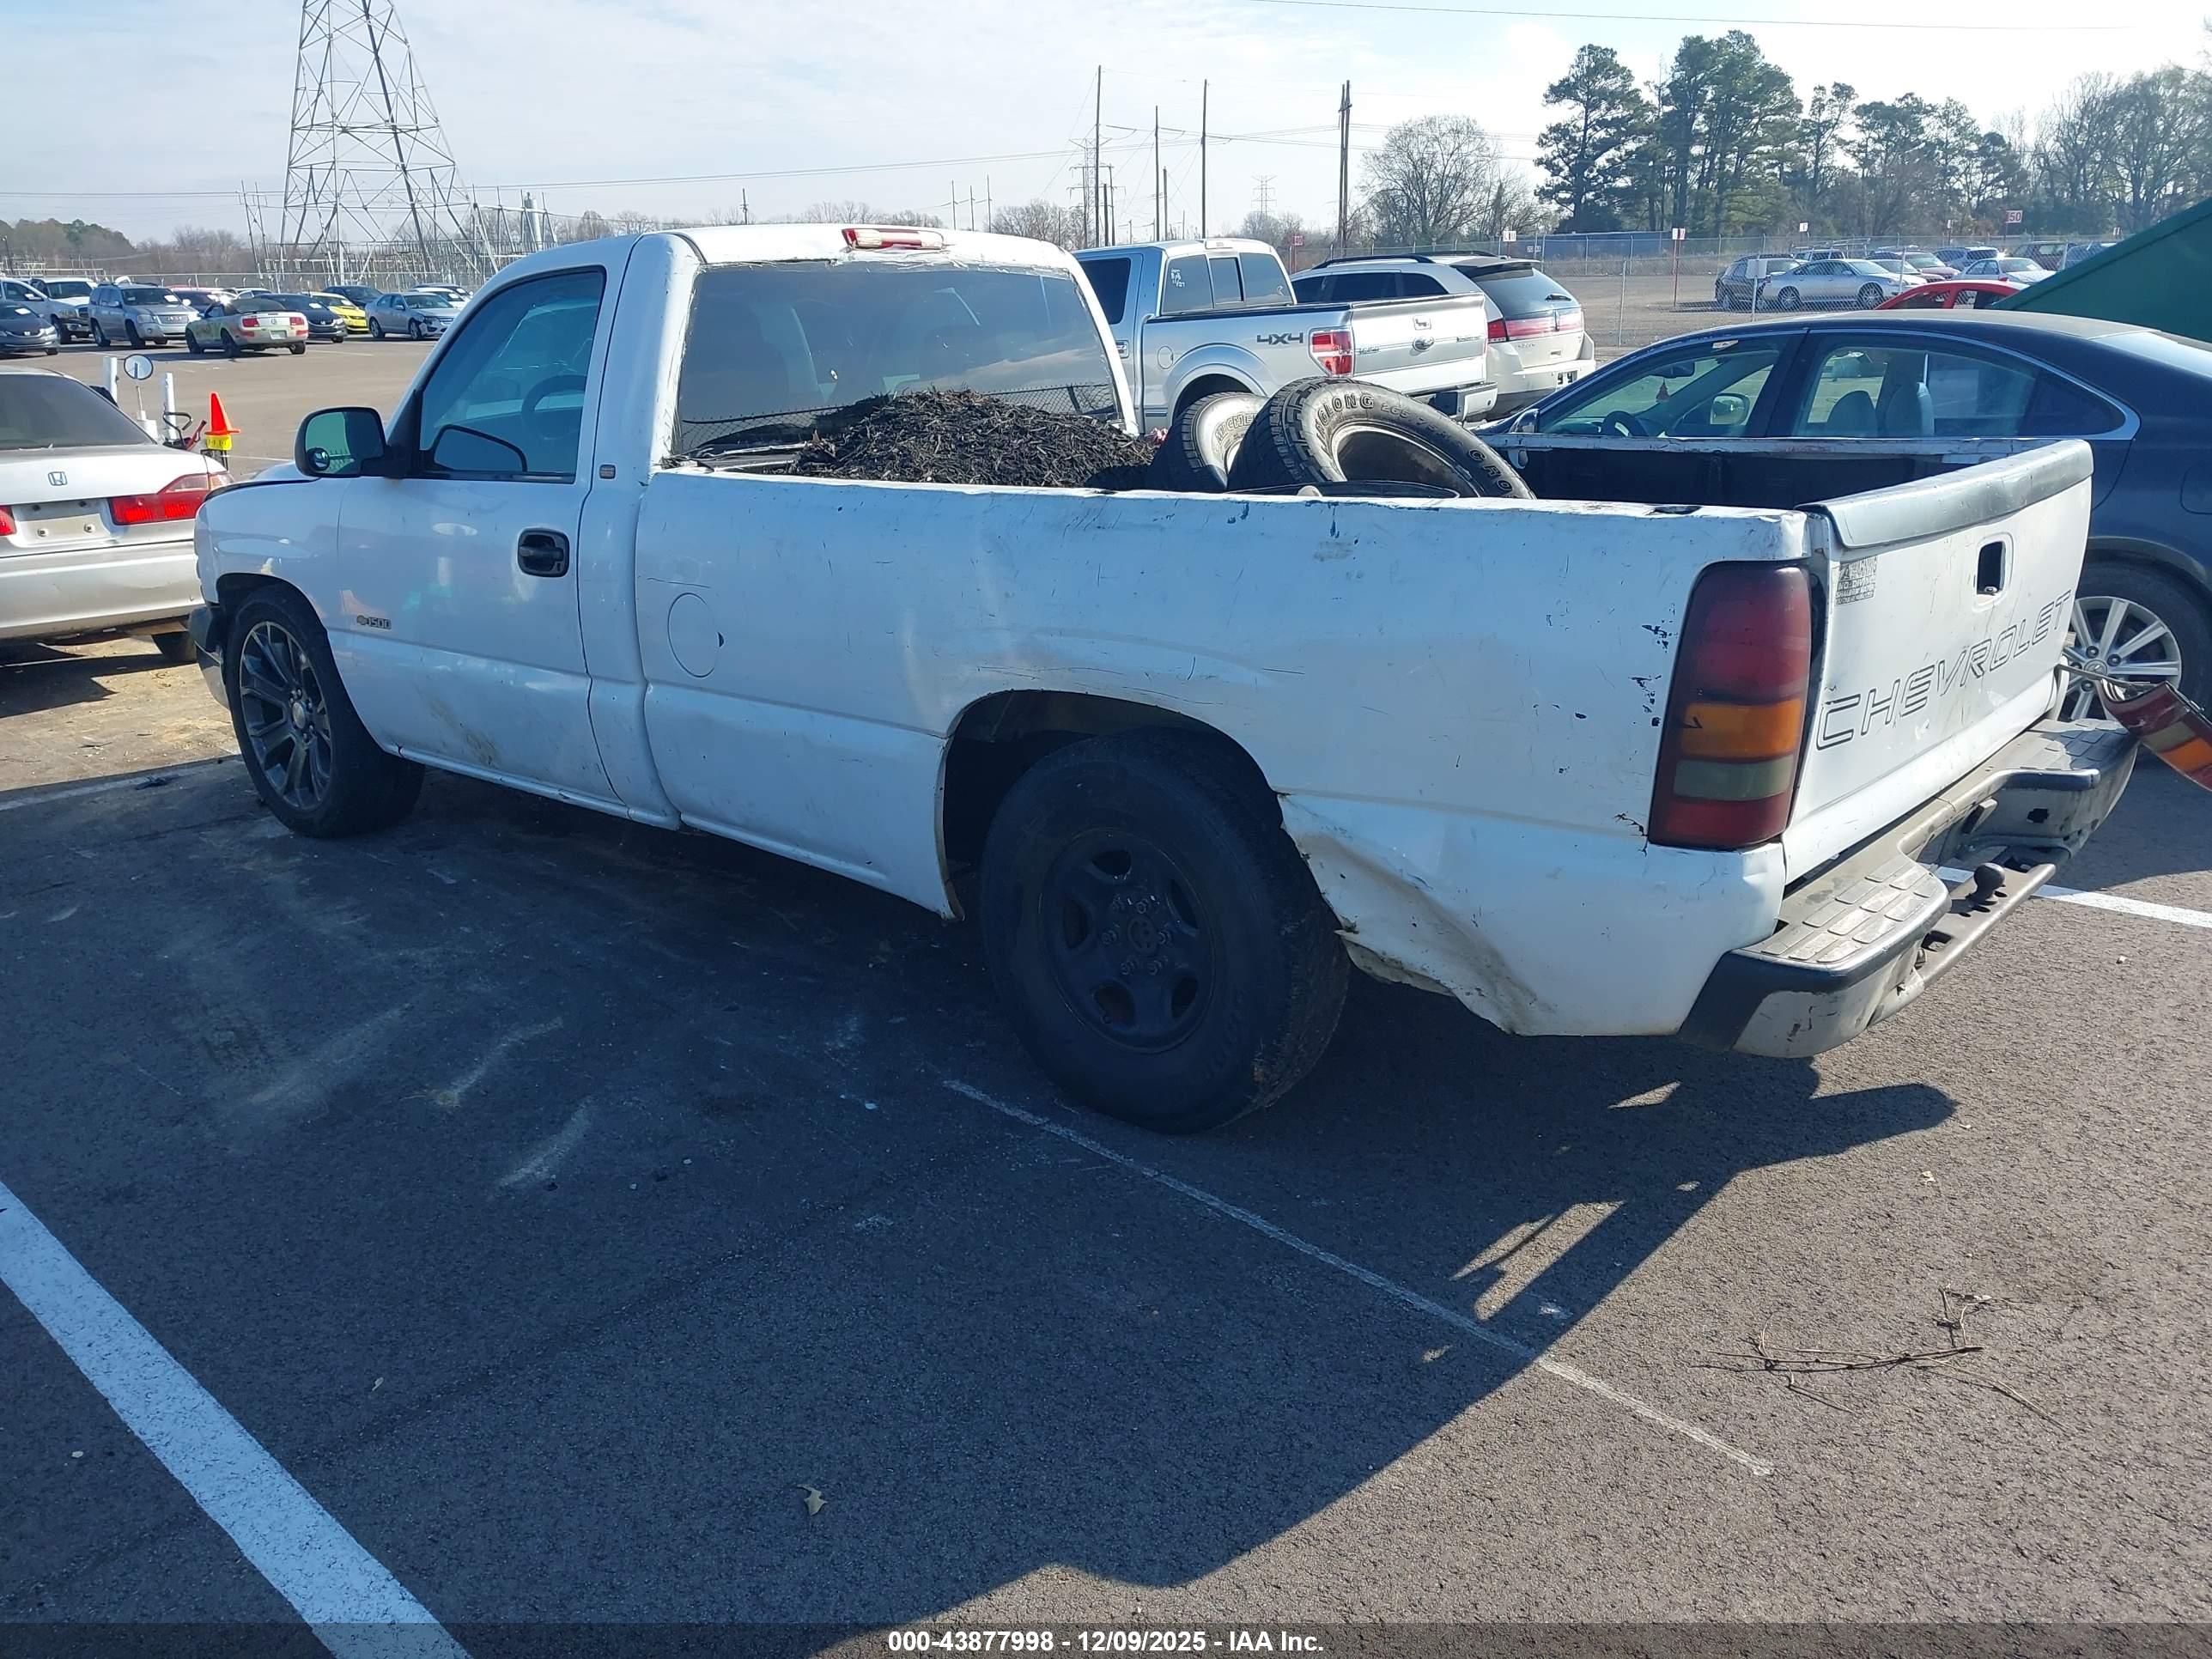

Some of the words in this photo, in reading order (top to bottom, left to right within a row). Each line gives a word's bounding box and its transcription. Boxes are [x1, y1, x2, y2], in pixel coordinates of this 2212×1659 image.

[1315, 392, 1375, 458] LINGLONG
[368, 617, 392, 629] 1500
[1816, 589, 2072, 751] CHEVROLET
